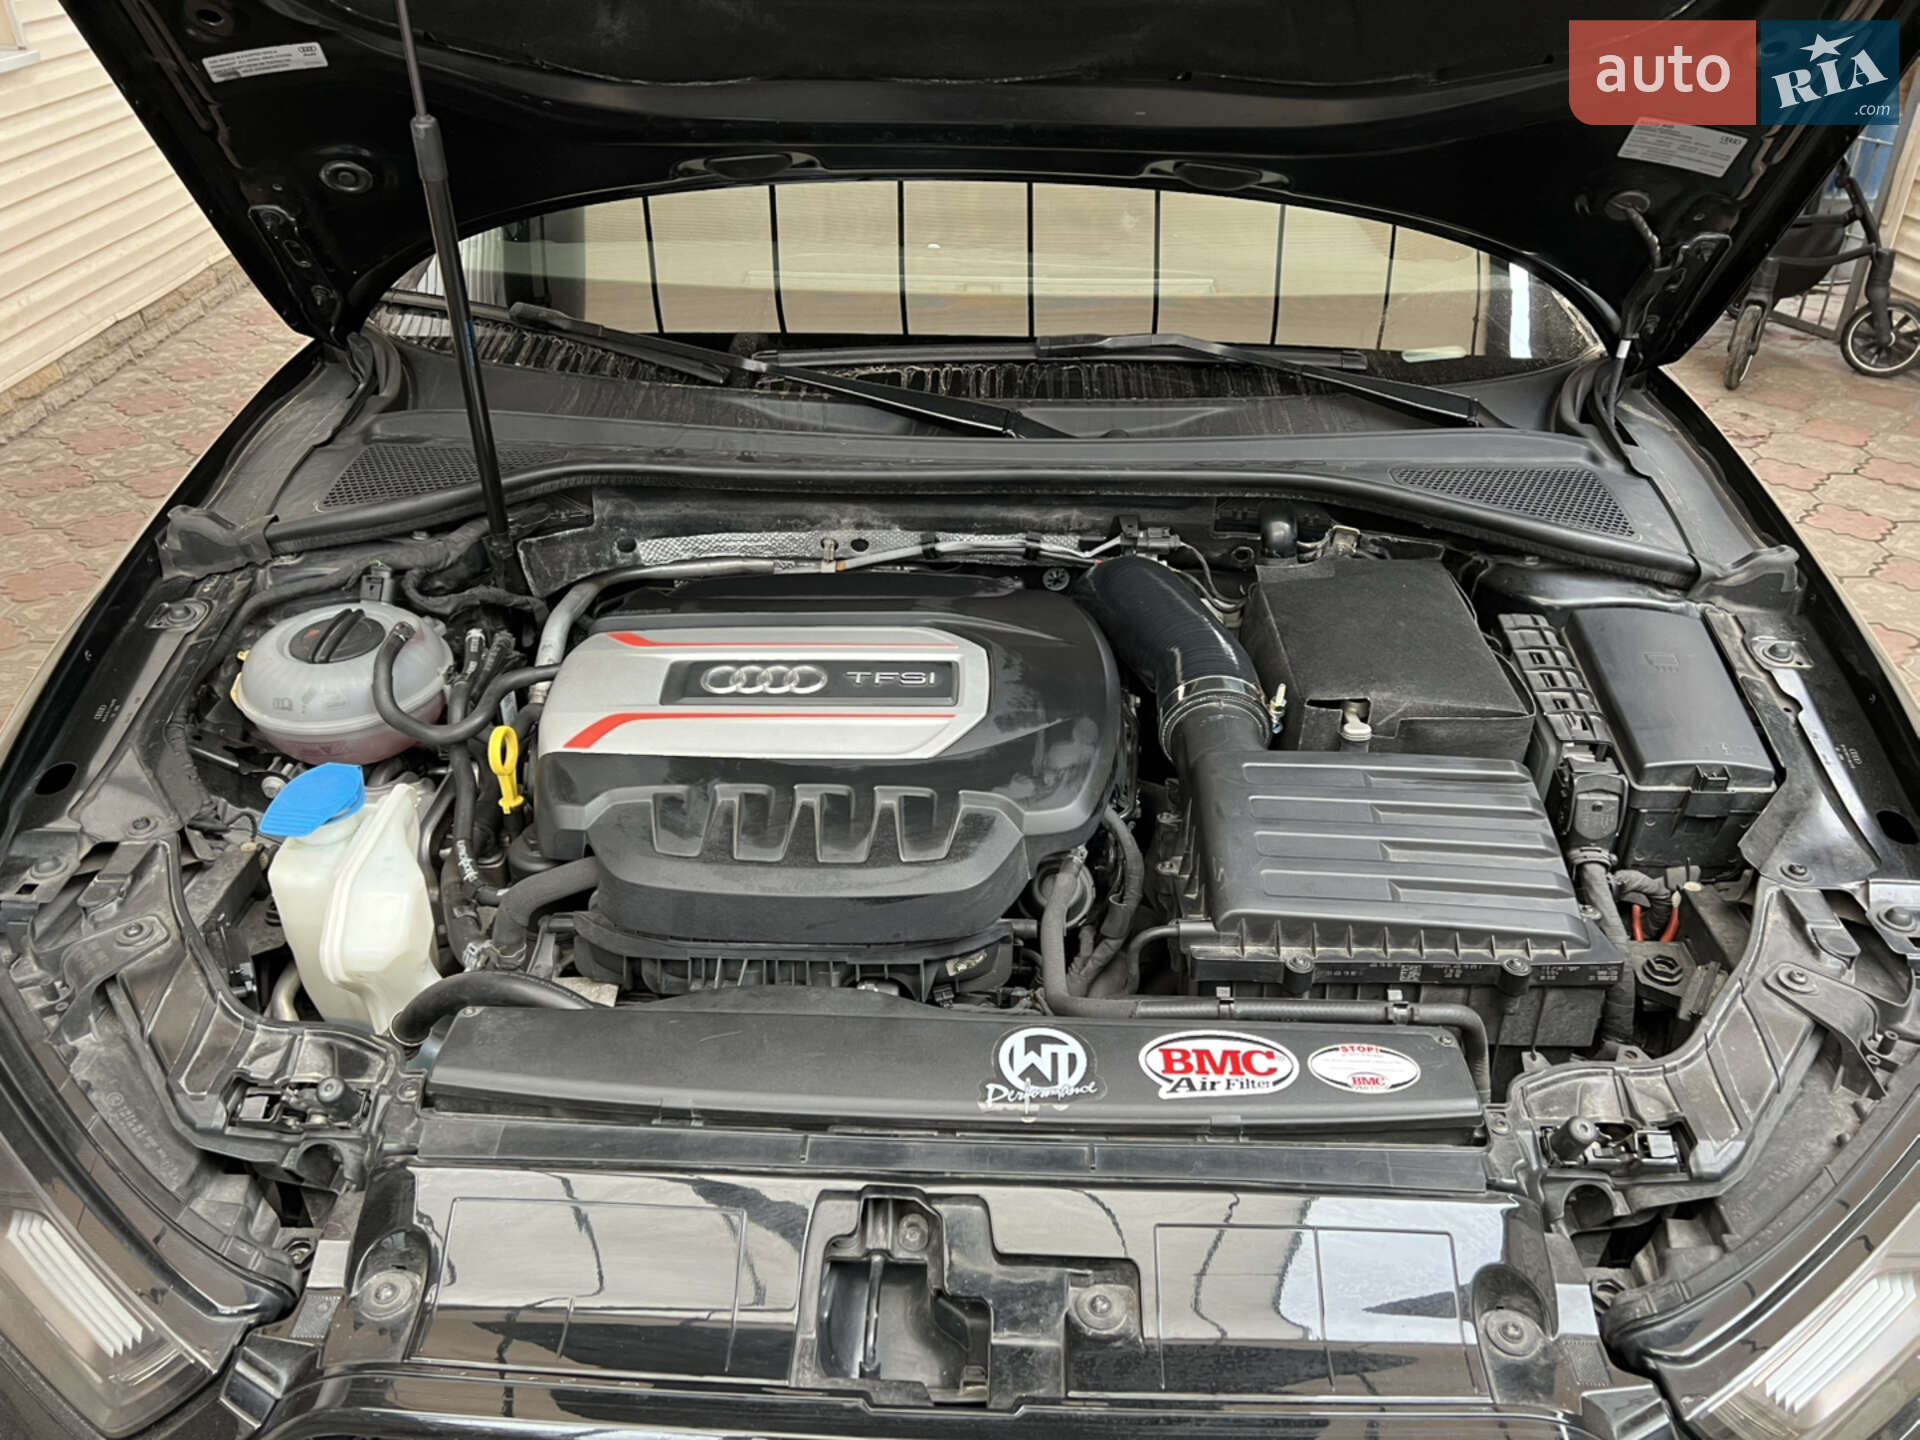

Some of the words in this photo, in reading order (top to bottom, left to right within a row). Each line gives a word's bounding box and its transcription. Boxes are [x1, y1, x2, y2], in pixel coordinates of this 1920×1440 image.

[846, 671, 936, 685] TFSI
[1158, 1048, 1278, 1077] BMC
[1166, 1076, 1221, 1094] Air
[1225, 1077, 1270, 1091] Filter
